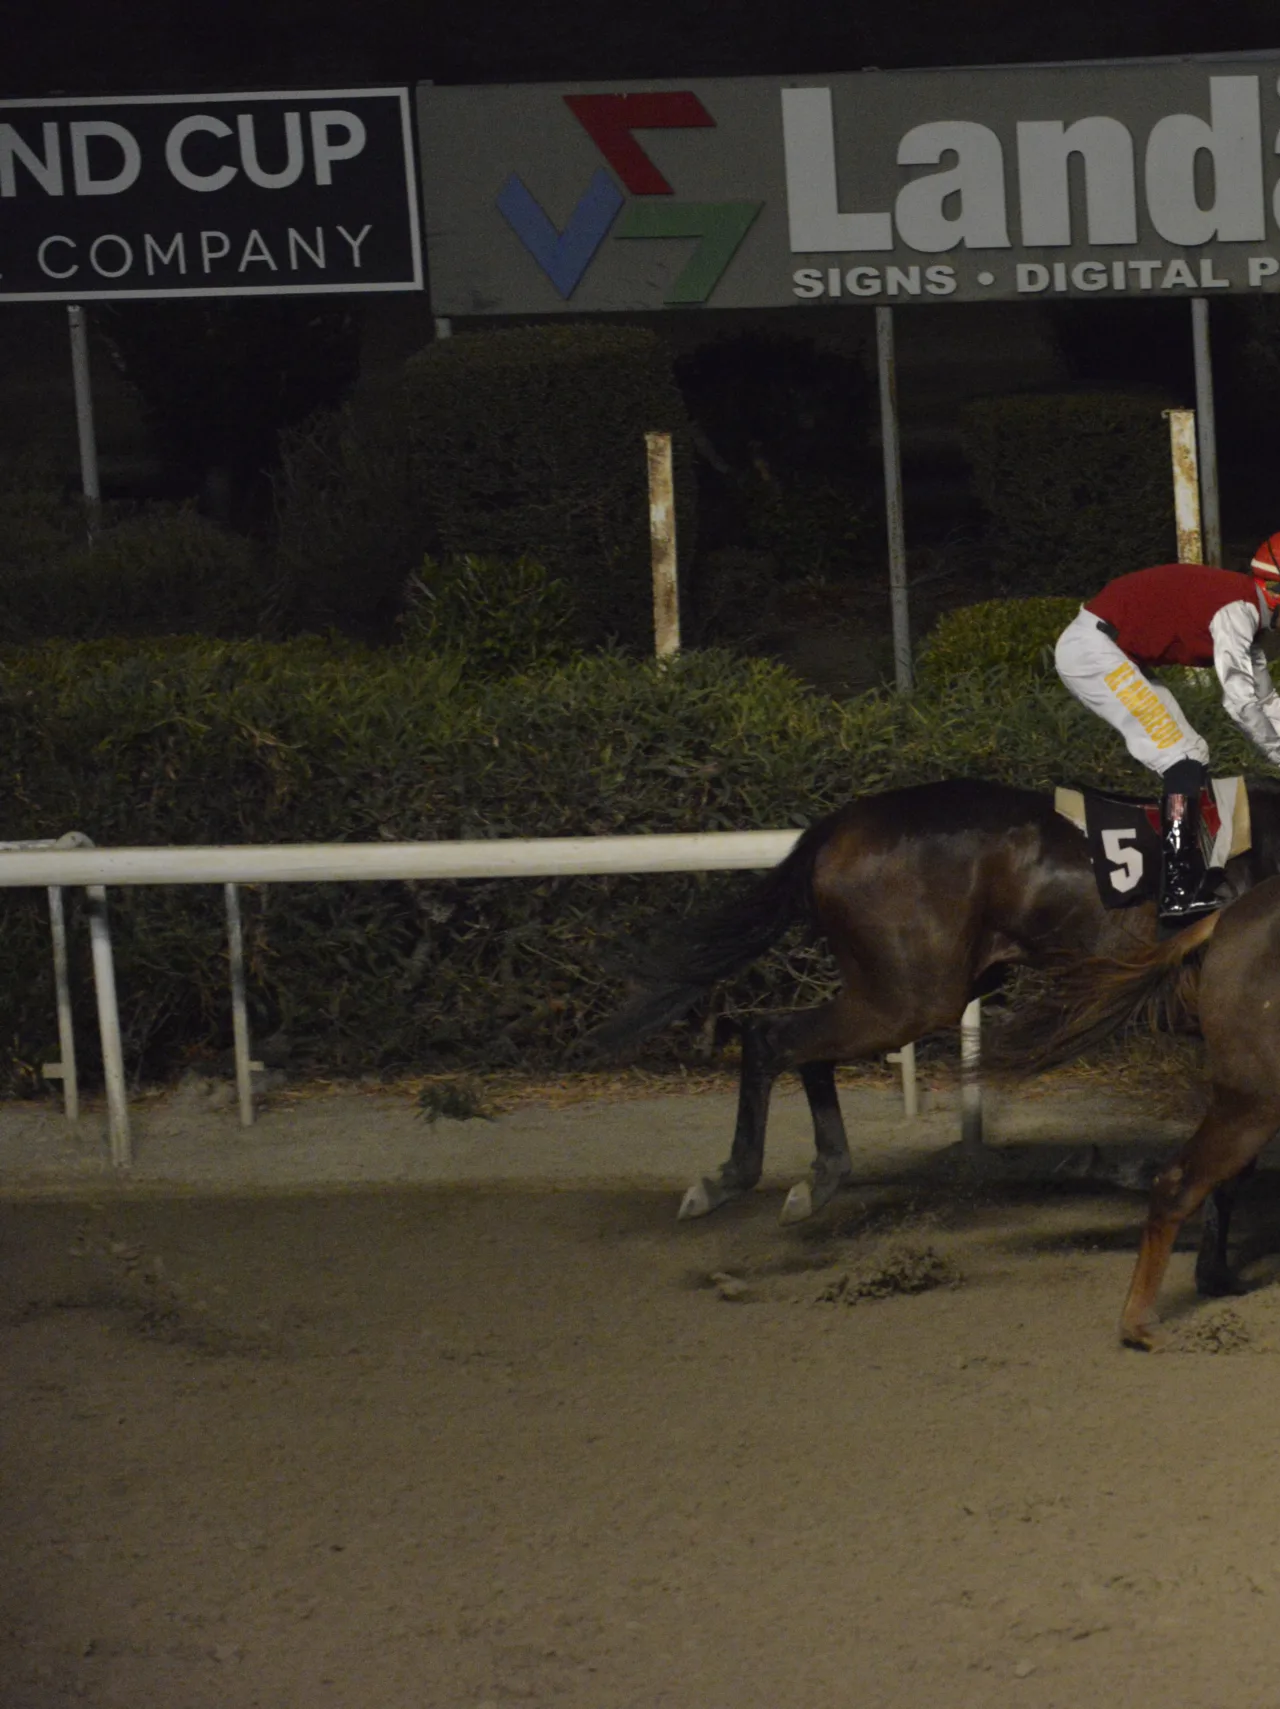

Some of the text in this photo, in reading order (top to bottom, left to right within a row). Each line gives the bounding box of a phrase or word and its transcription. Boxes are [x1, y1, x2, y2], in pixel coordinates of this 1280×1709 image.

[0, 109, 367, 197] ND CUP
[37, 224, 373, 280] COMPANY
[792, 264, 957, 298] SIGNS
[1015, 258, 1230, 293] DIGITAL
[1101, 828, 1144, 893] 5
